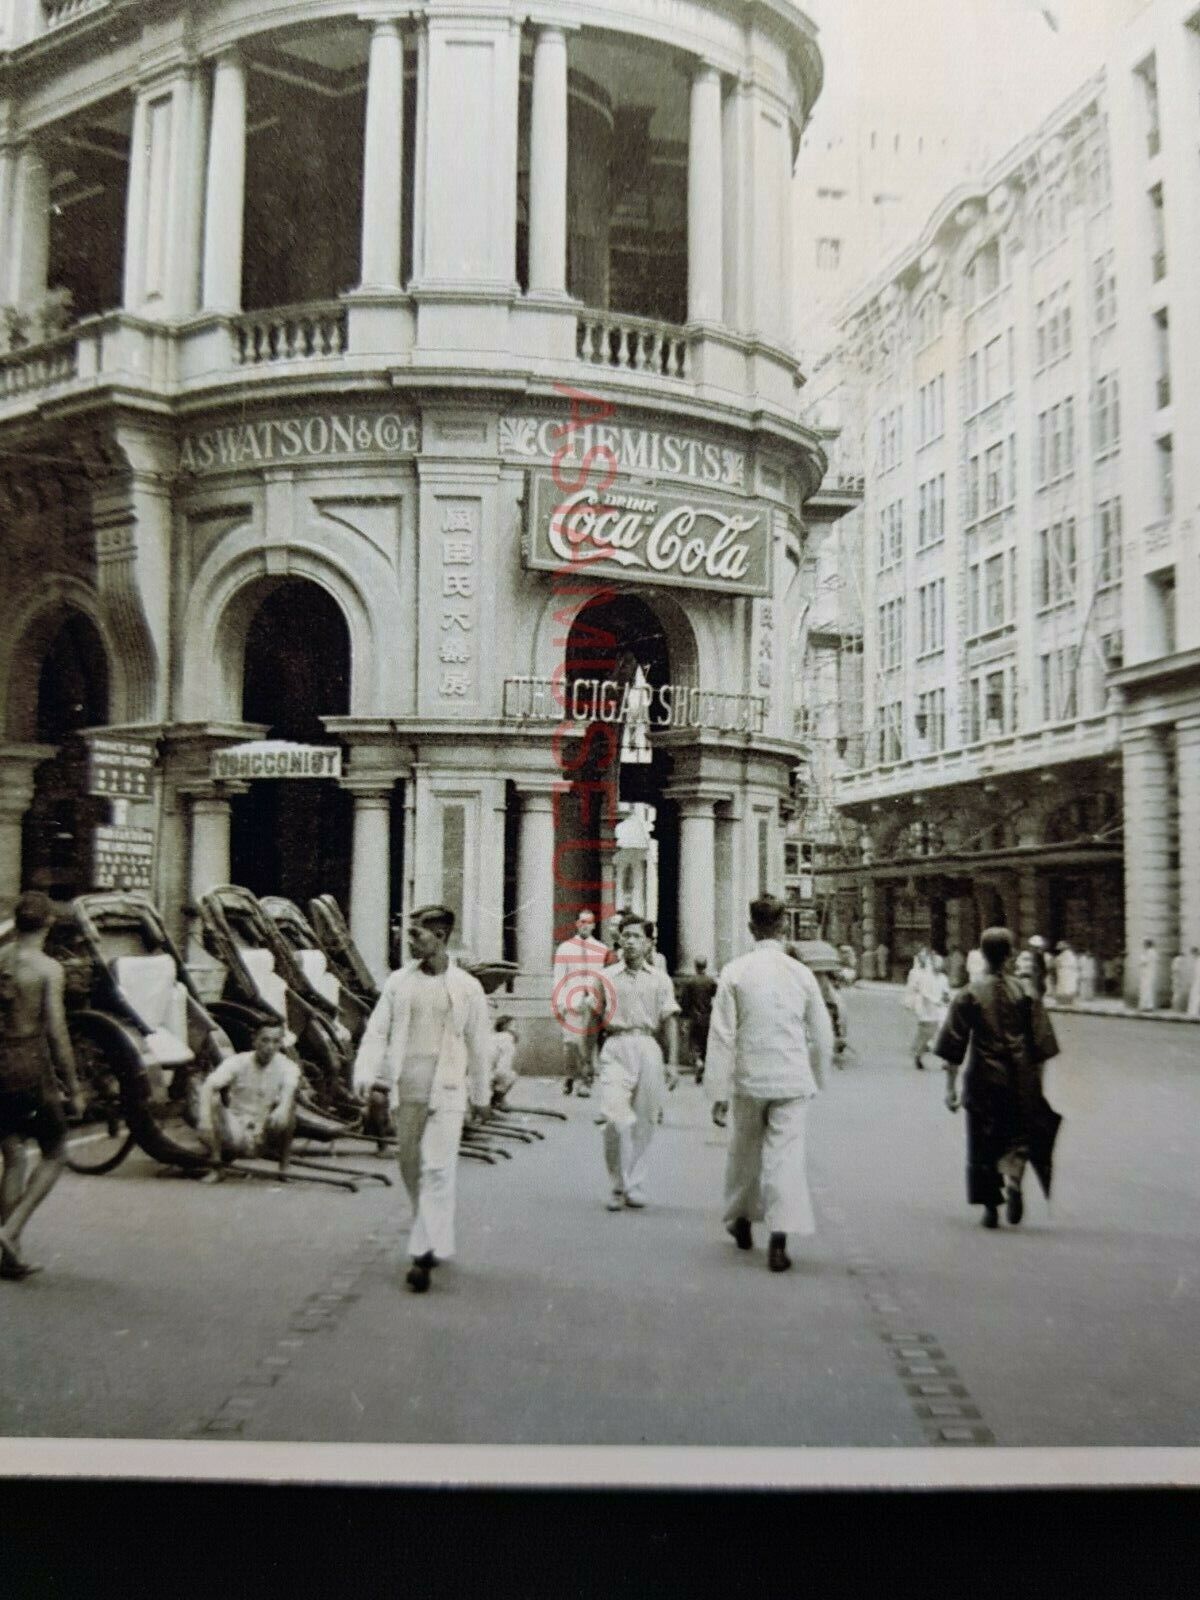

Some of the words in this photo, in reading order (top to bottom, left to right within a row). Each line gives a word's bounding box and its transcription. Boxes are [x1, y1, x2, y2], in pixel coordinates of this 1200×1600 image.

[537, 418, 722, 481] CHEMISTS
[605, 493, 658, 513] DRINK
[573, 678, 654, 724] CIGAR
[657, 684, 724, 731] SHO
